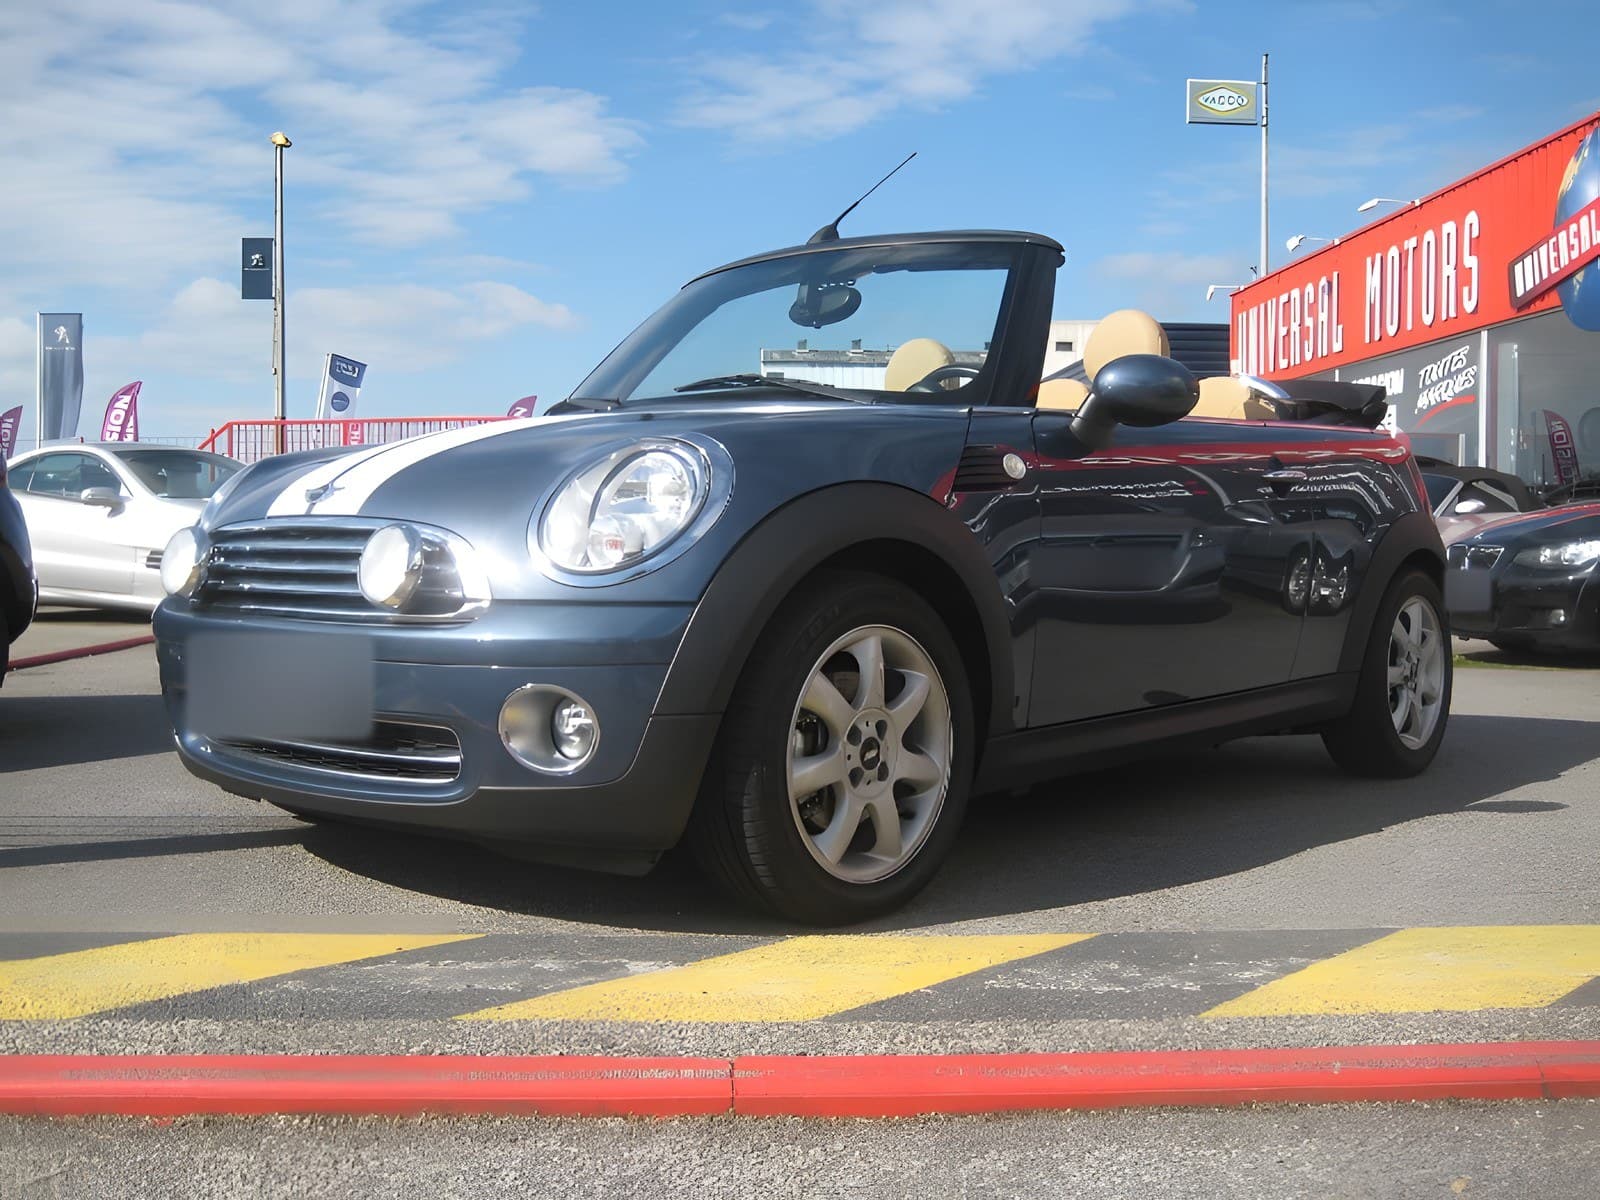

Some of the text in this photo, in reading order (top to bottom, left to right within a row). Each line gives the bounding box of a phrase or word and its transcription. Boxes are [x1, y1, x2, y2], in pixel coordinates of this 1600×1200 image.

[1237, 210, 1480, 376] UNIVERSAL MOTORS
[1514, 209, 1600, 298] UNIVERSAL
